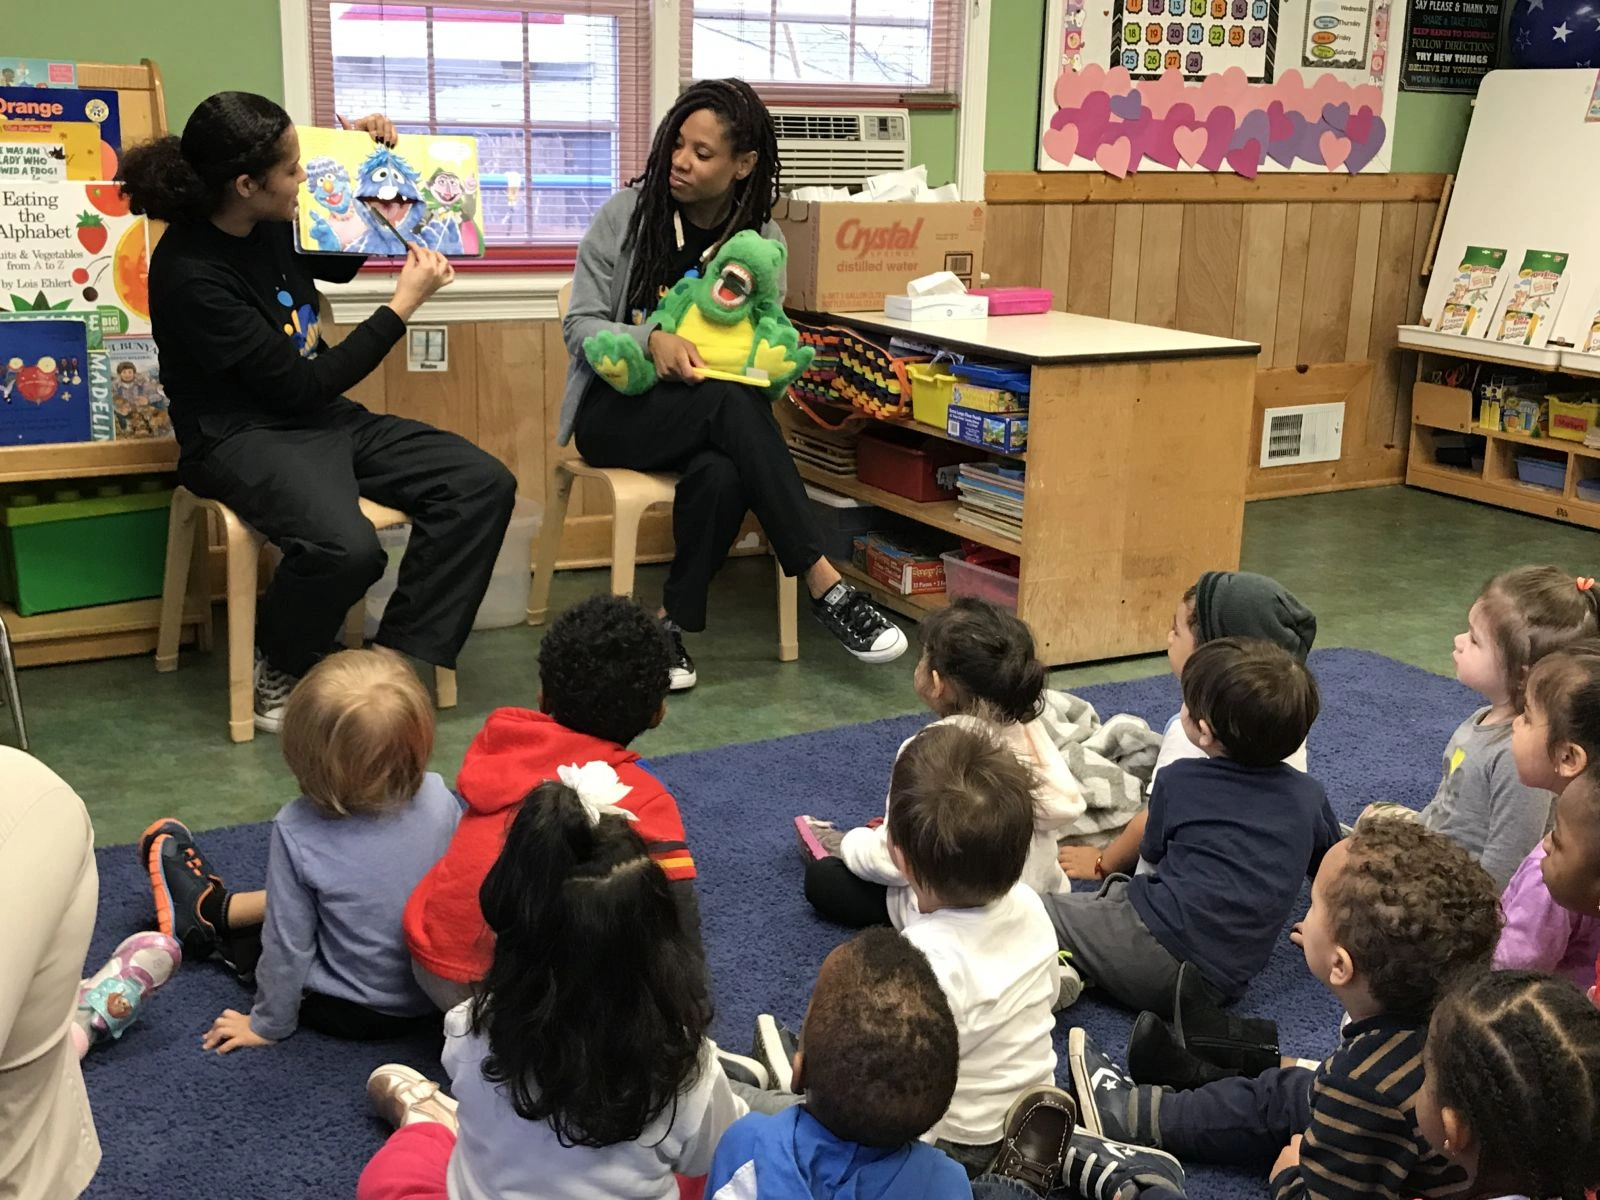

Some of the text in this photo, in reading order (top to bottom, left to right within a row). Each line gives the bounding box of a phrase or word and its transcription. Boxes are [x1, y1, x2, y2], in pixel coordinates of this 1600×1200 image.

[1172, 1, 1181, 10] 13
[1194, 1, 1202, 11] 14
[1214, 2, 1222, 12] 15
[1235, 4, 1244, 13] 16
[1256, 4, 1263, 13] 17
[1340, 5, 1366, 13] Wednesday
[1428, 0, 1453, 12] PLEASE
[1454, 2, 1460, 12] &
[1462, 3, 1484, 14] THANK
[1485, 4, 1499, 15] YOU
[1338, 20, 1360, 28] Thursday
[1128, 28, 1261, 41] 18 19 20 21 22 23 24
[1412, 38, 1495, 52] FOLLOW DIRECTIONS
[1125, 55, 1199, 68] 25 26 27 28
[1416, 52, 1488, 64] TRY NEW THINGS
[1408, 64, 1440, 72] BELIEVE
[24, 156, 48, 165] WHO
[22, 167, 28, 175] A
[30, 166, 58, 175] FROG!
[2, 190, 59, 210] Eating
[18, 208, 46, 223] the
[835, 217, 925, 260] Crystal
[20, 250, 28, 260] &
[32, 249, 84, 261] Vegetables
[7, 260, 64, 270] from A to Z
[837, 260, 919, 272] distilled water
[2, 278, 72, 290] by Lois Ehlert
[102, 316, 118, 326] BIG
